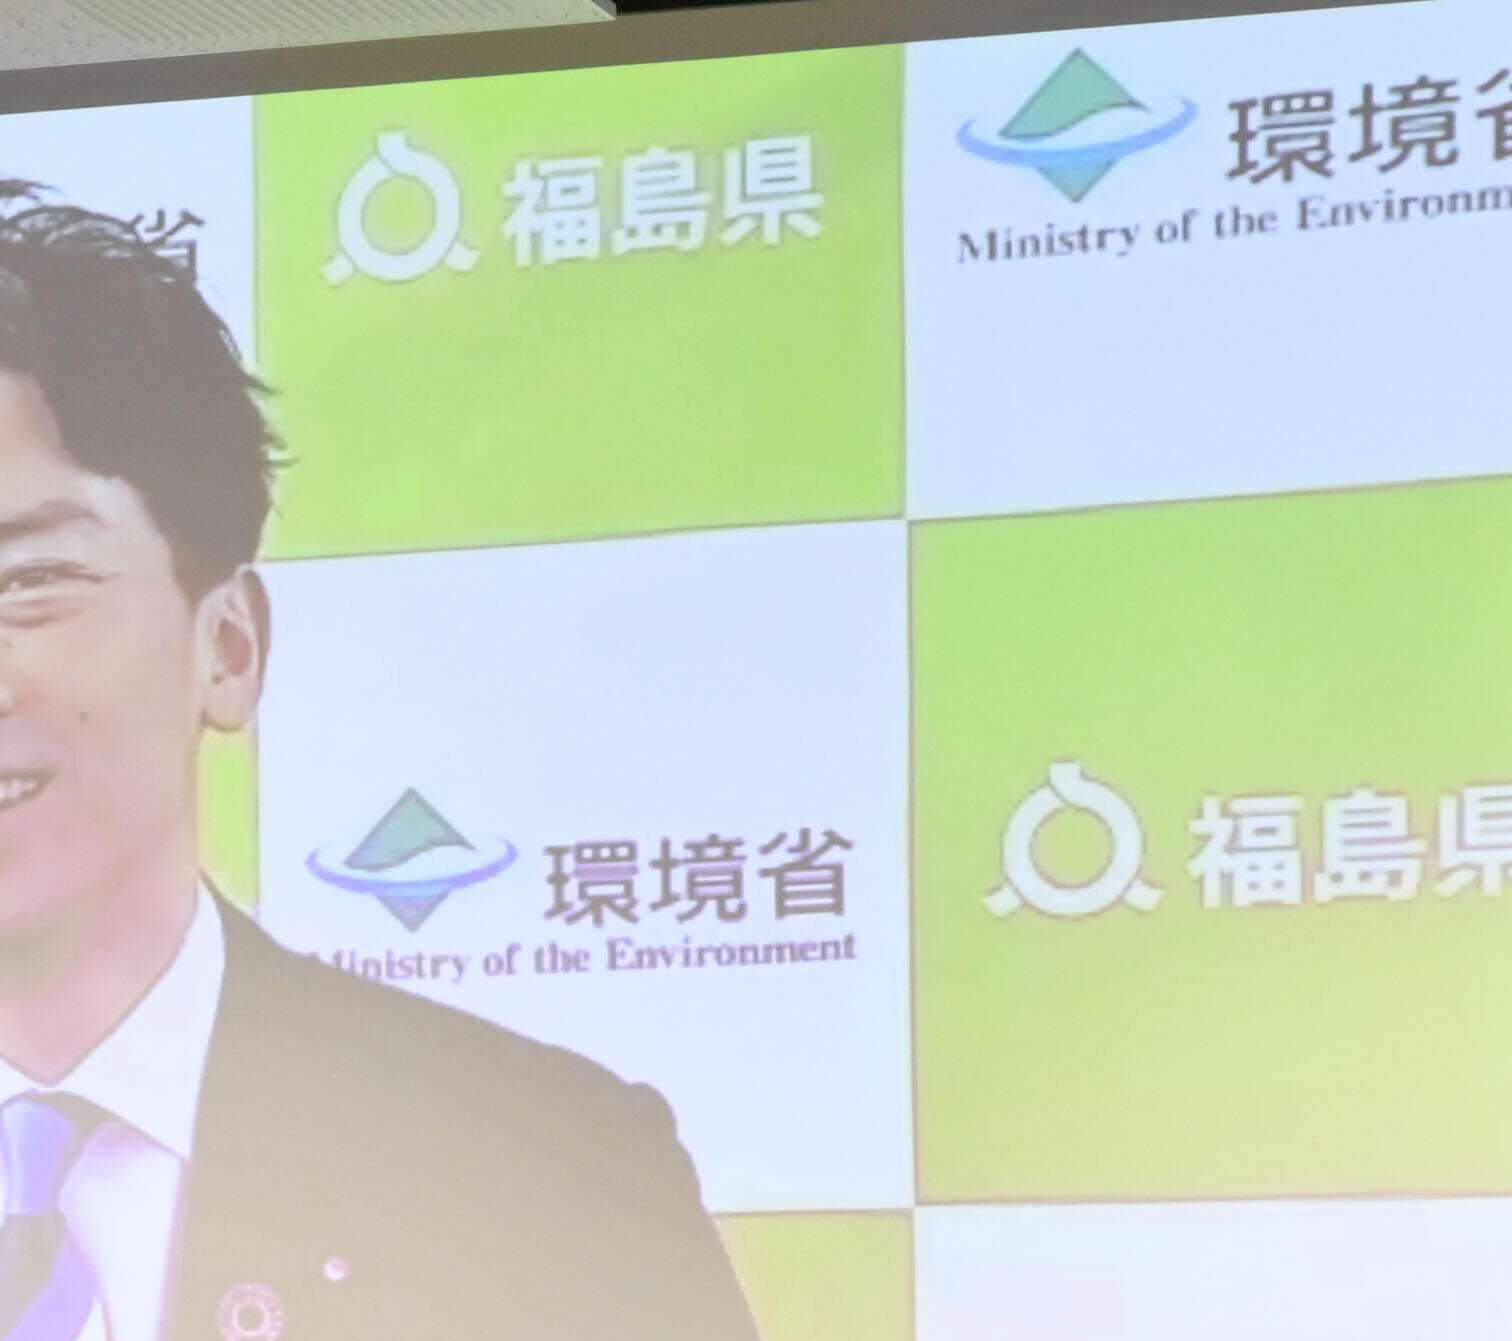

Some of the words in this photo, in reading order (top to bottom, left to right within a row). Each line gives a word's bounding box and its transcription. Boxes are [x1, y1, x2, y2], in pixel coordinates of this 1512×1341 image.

[502, 134, 824, 268] 福島県
[957, 218, 1139, 263] Ministry
[1156, 209, 1200, 245] of
[1215, 204, 1277, 237] the
[544, 827, 854, 928] 環境省
[483, 941, 522, 976] of
[534, 940, 590, 975] the
[606, 932, 857, 971] Environment
